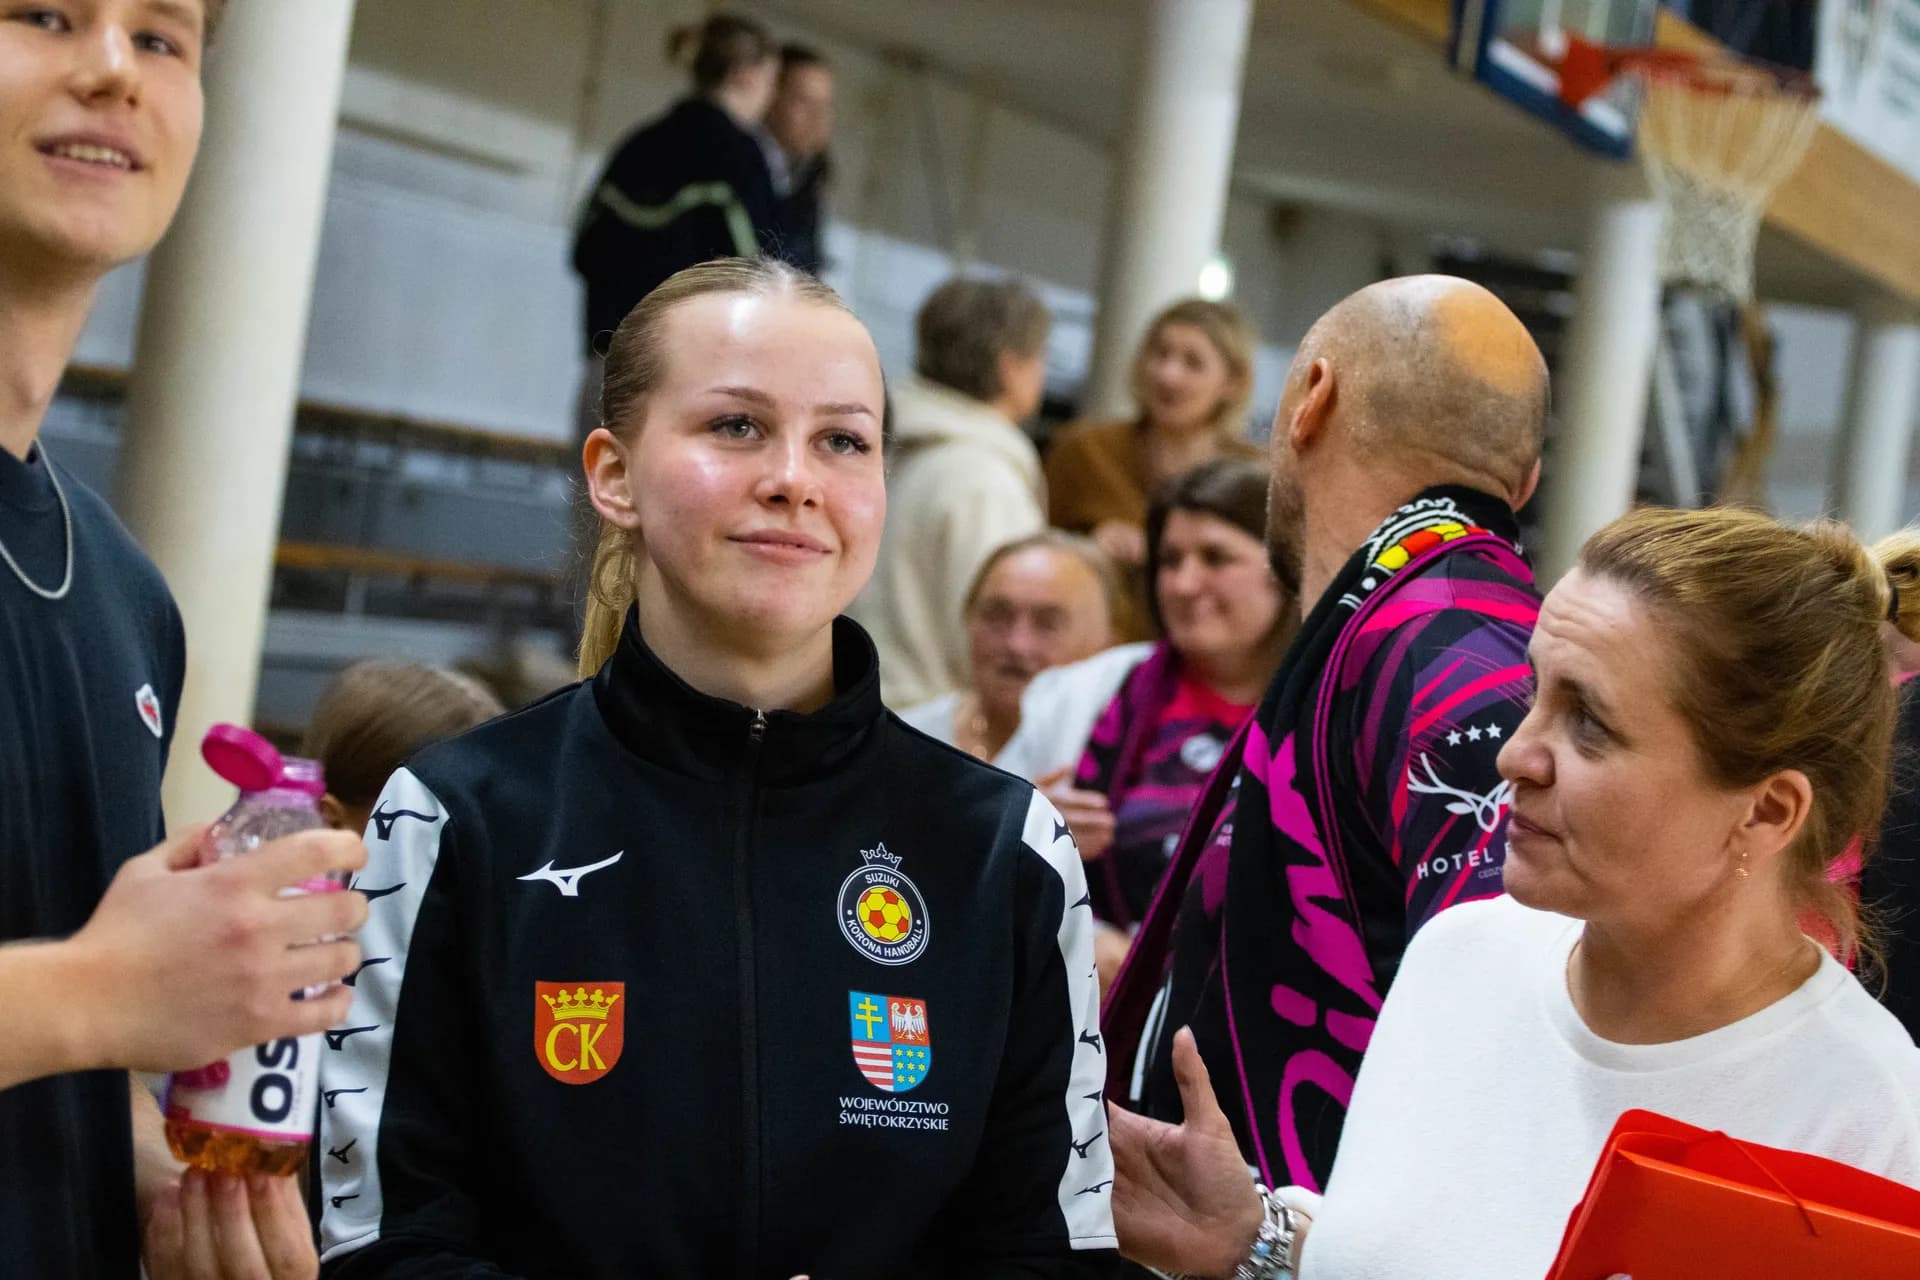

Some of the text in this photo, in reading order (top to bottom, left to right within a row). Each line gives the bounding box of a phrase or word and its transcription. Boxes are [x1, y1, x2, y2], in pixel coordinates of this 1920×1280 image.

[1416, 847, 1494, 880] HOTEL
[865, 872, 900, 888] SUZUKI
[847, 919, 923, 957] KORONA HANDBALL
[545, 1022, 609, 1072] CK
[839, 1096, 950, 1116] WOJEWÓDZTWO
[839, 1109, 950, 1131] ŚWIĘTOKRZYSKIE
